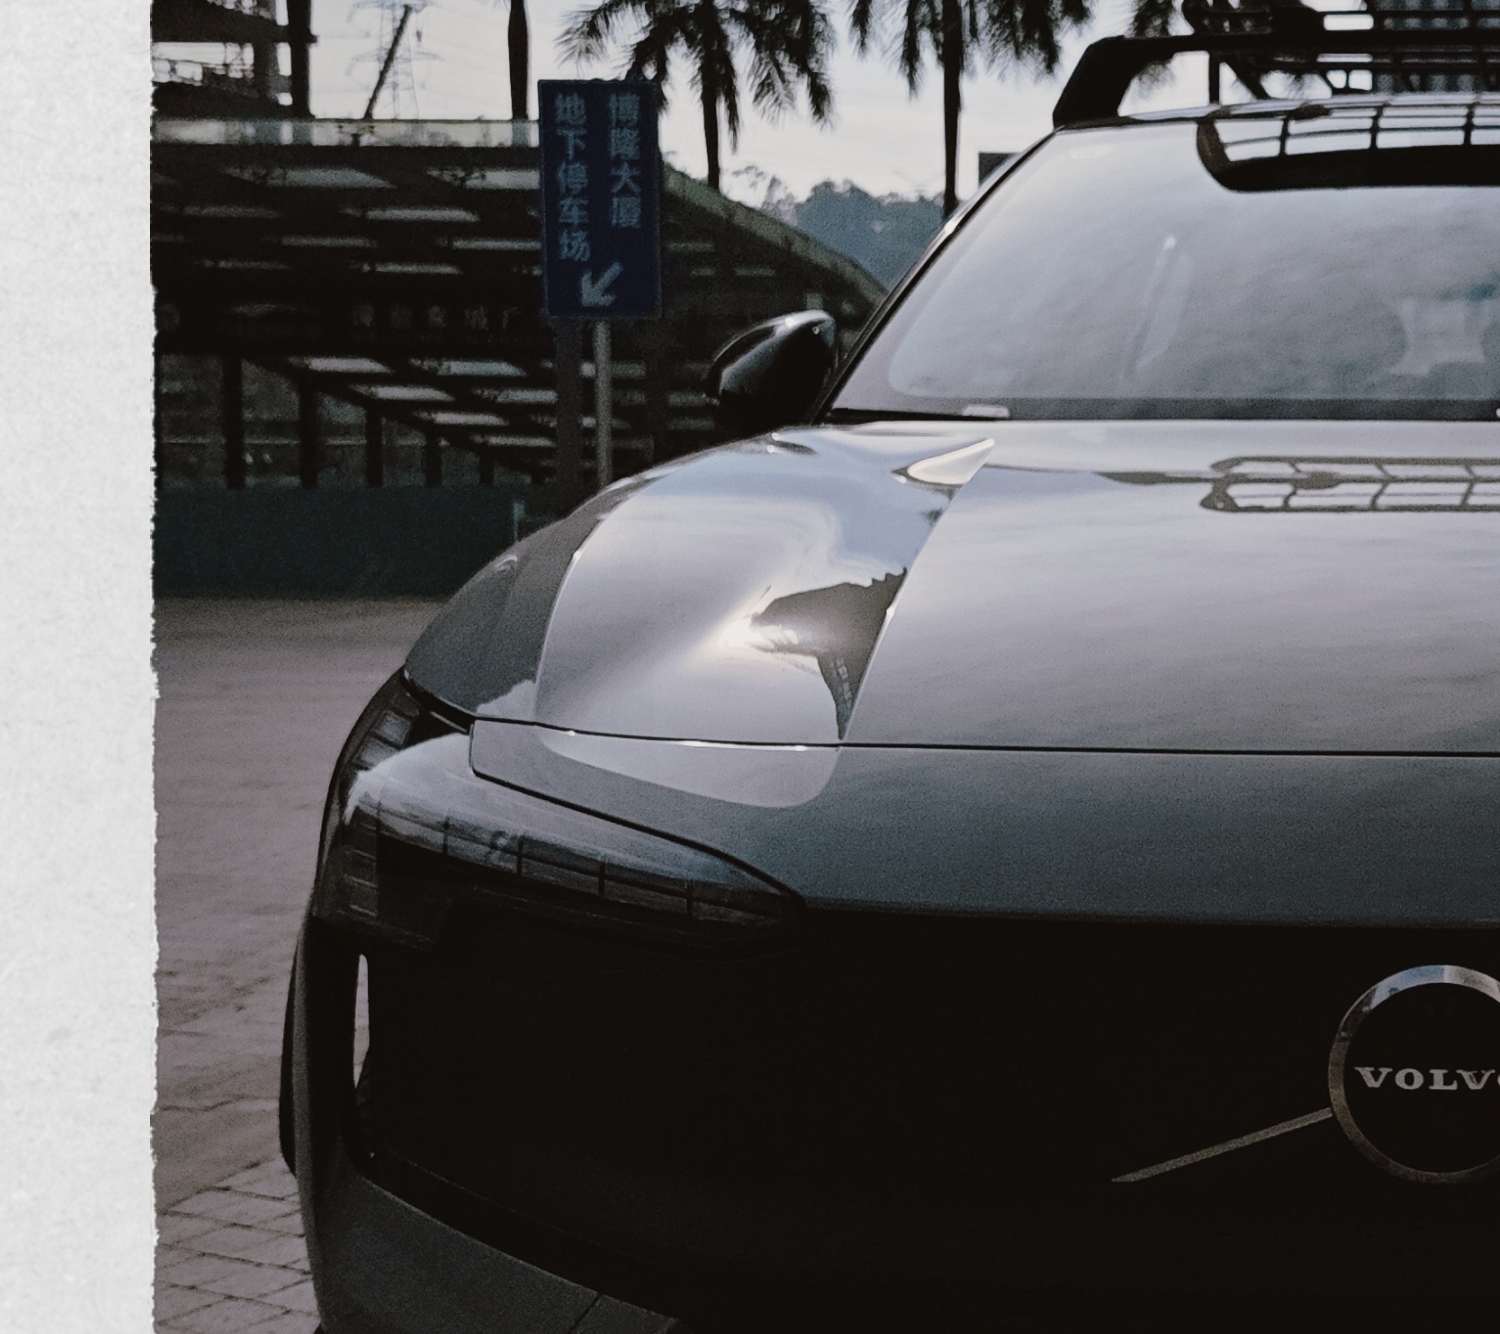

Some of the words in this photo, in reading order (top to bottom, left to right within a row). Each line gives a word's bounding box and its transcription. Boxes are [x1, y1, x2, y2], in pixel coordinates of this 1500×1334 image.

[553, 91, 592, 262] 地下停车场
